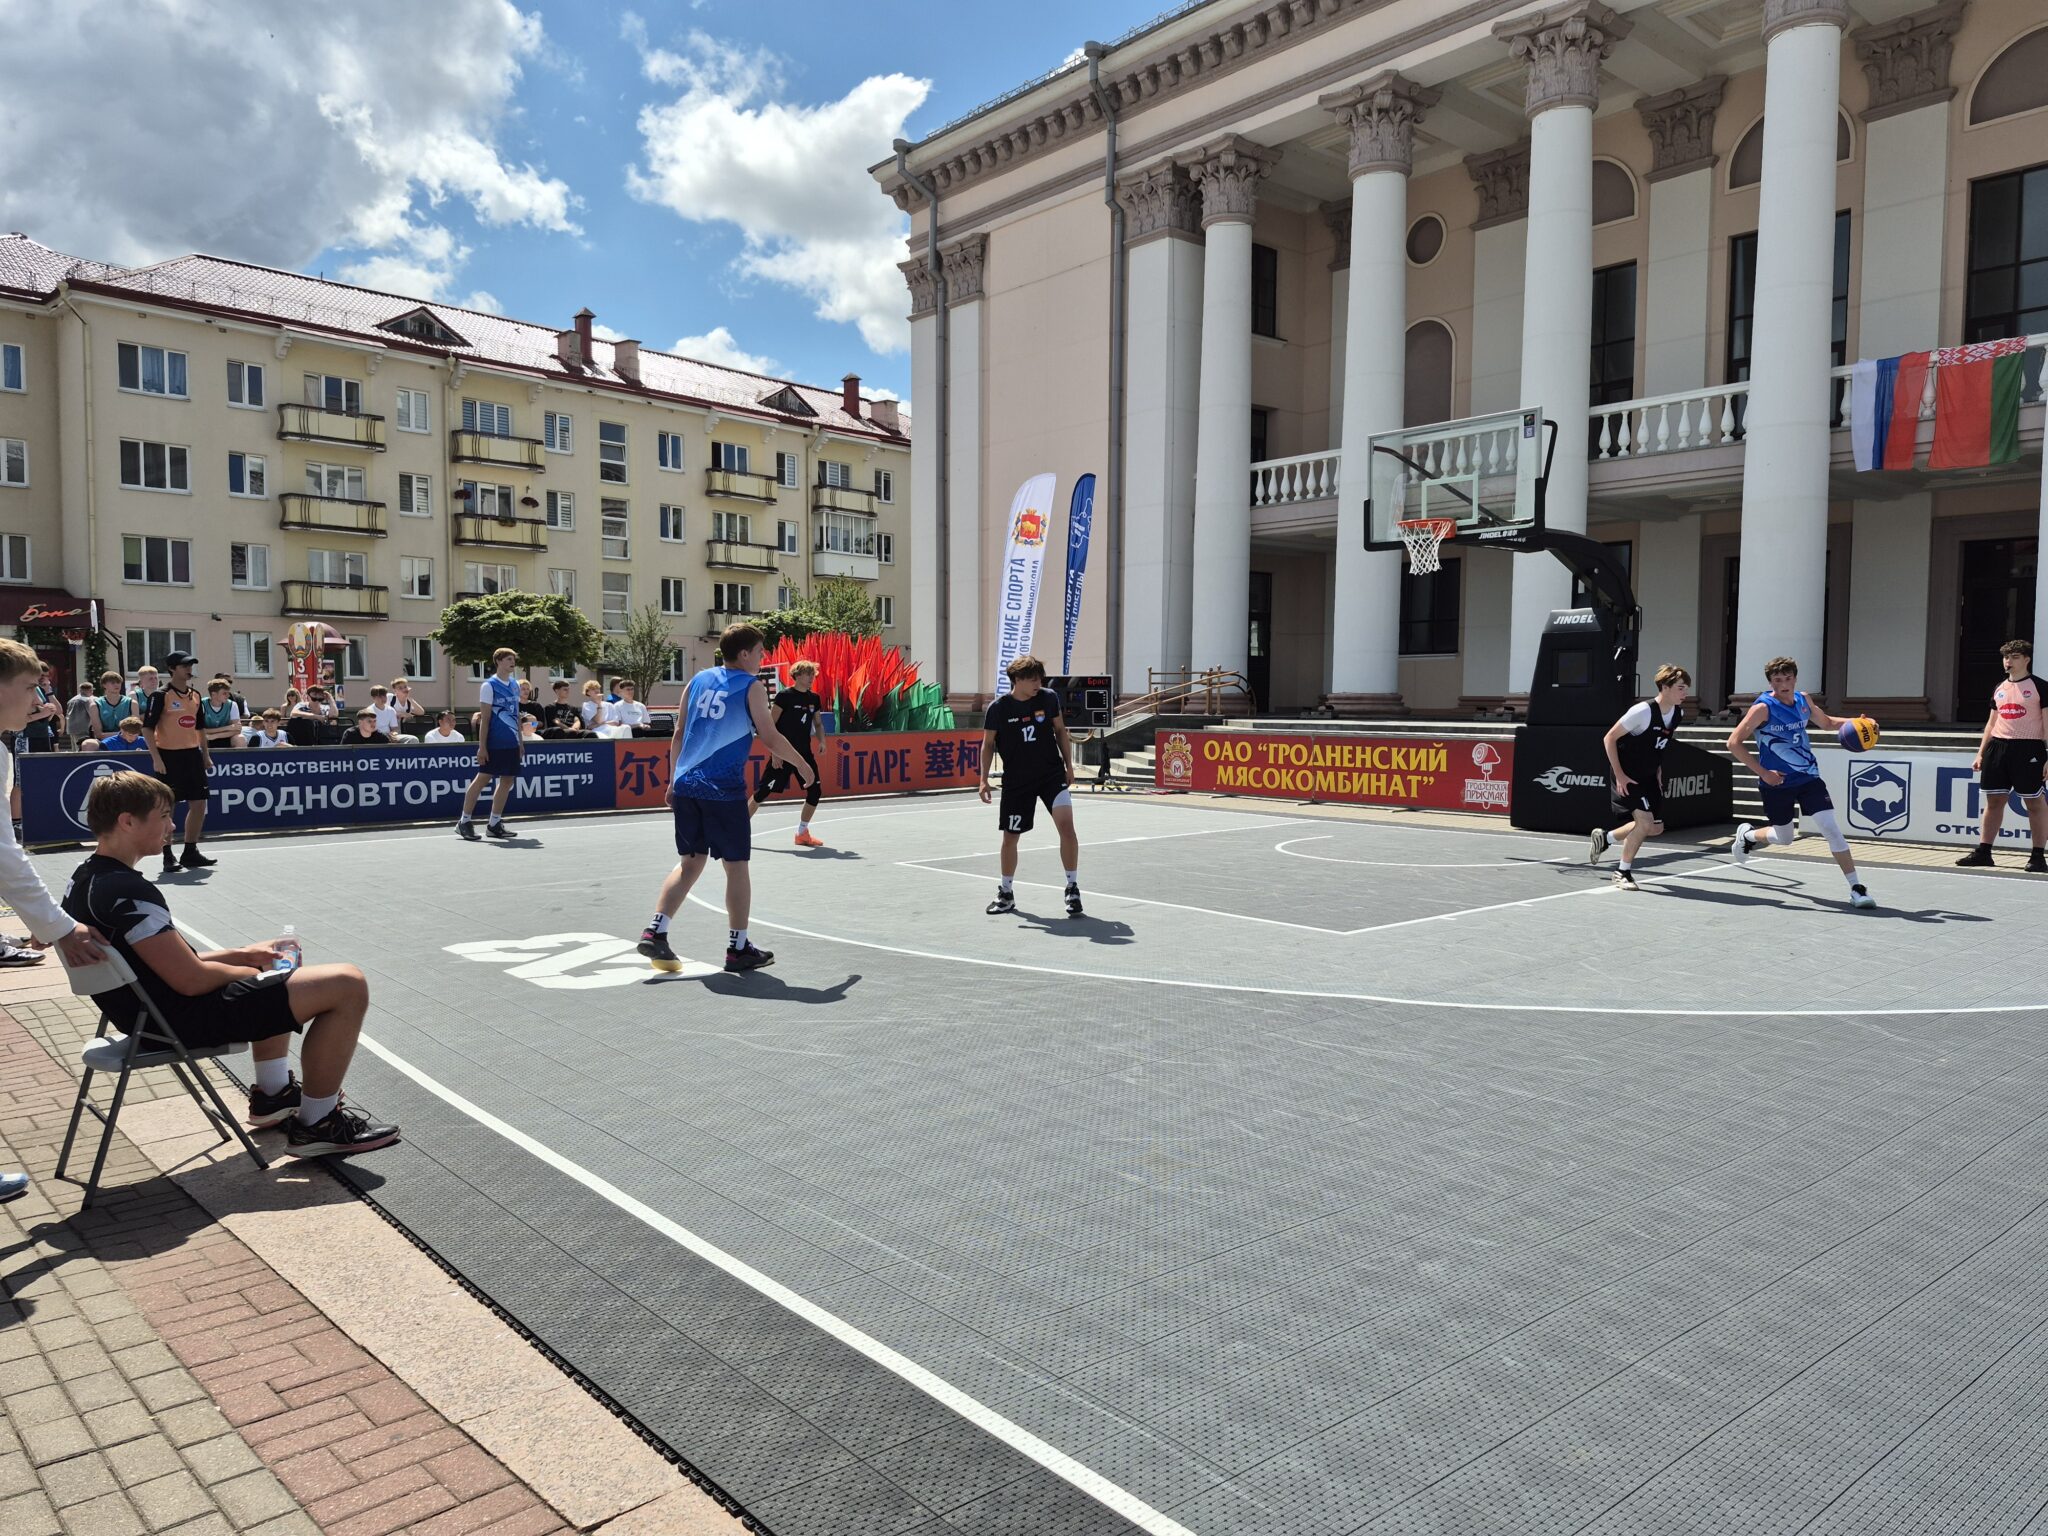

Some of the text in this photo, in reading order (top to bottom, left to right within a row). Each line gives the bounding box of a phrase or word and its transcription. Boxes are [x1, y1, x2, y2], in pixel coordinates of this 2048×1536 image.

[1006, 557, 1026, 611] СПОРТА
[1553, 614, 1594, 625] JINOEL
[696, 688, 729, 720] 45
[801, 713, 807, 724] 4
[1021, 725, 1036, 742] 12
[1792, 733, 1801, 744] 5
[1654, 736, 1669, 750] 14
[1203, 740, 1253, 763] ОАО
[767, 779, 776, 790] 4
[1558, 774, 1607, 788] JINOEL
[1664, 774, 1711, 799] JINOEL
[1008, 815, 1022, 831] 12
[1935, 823, 2032, 839] ОТКЫТ
